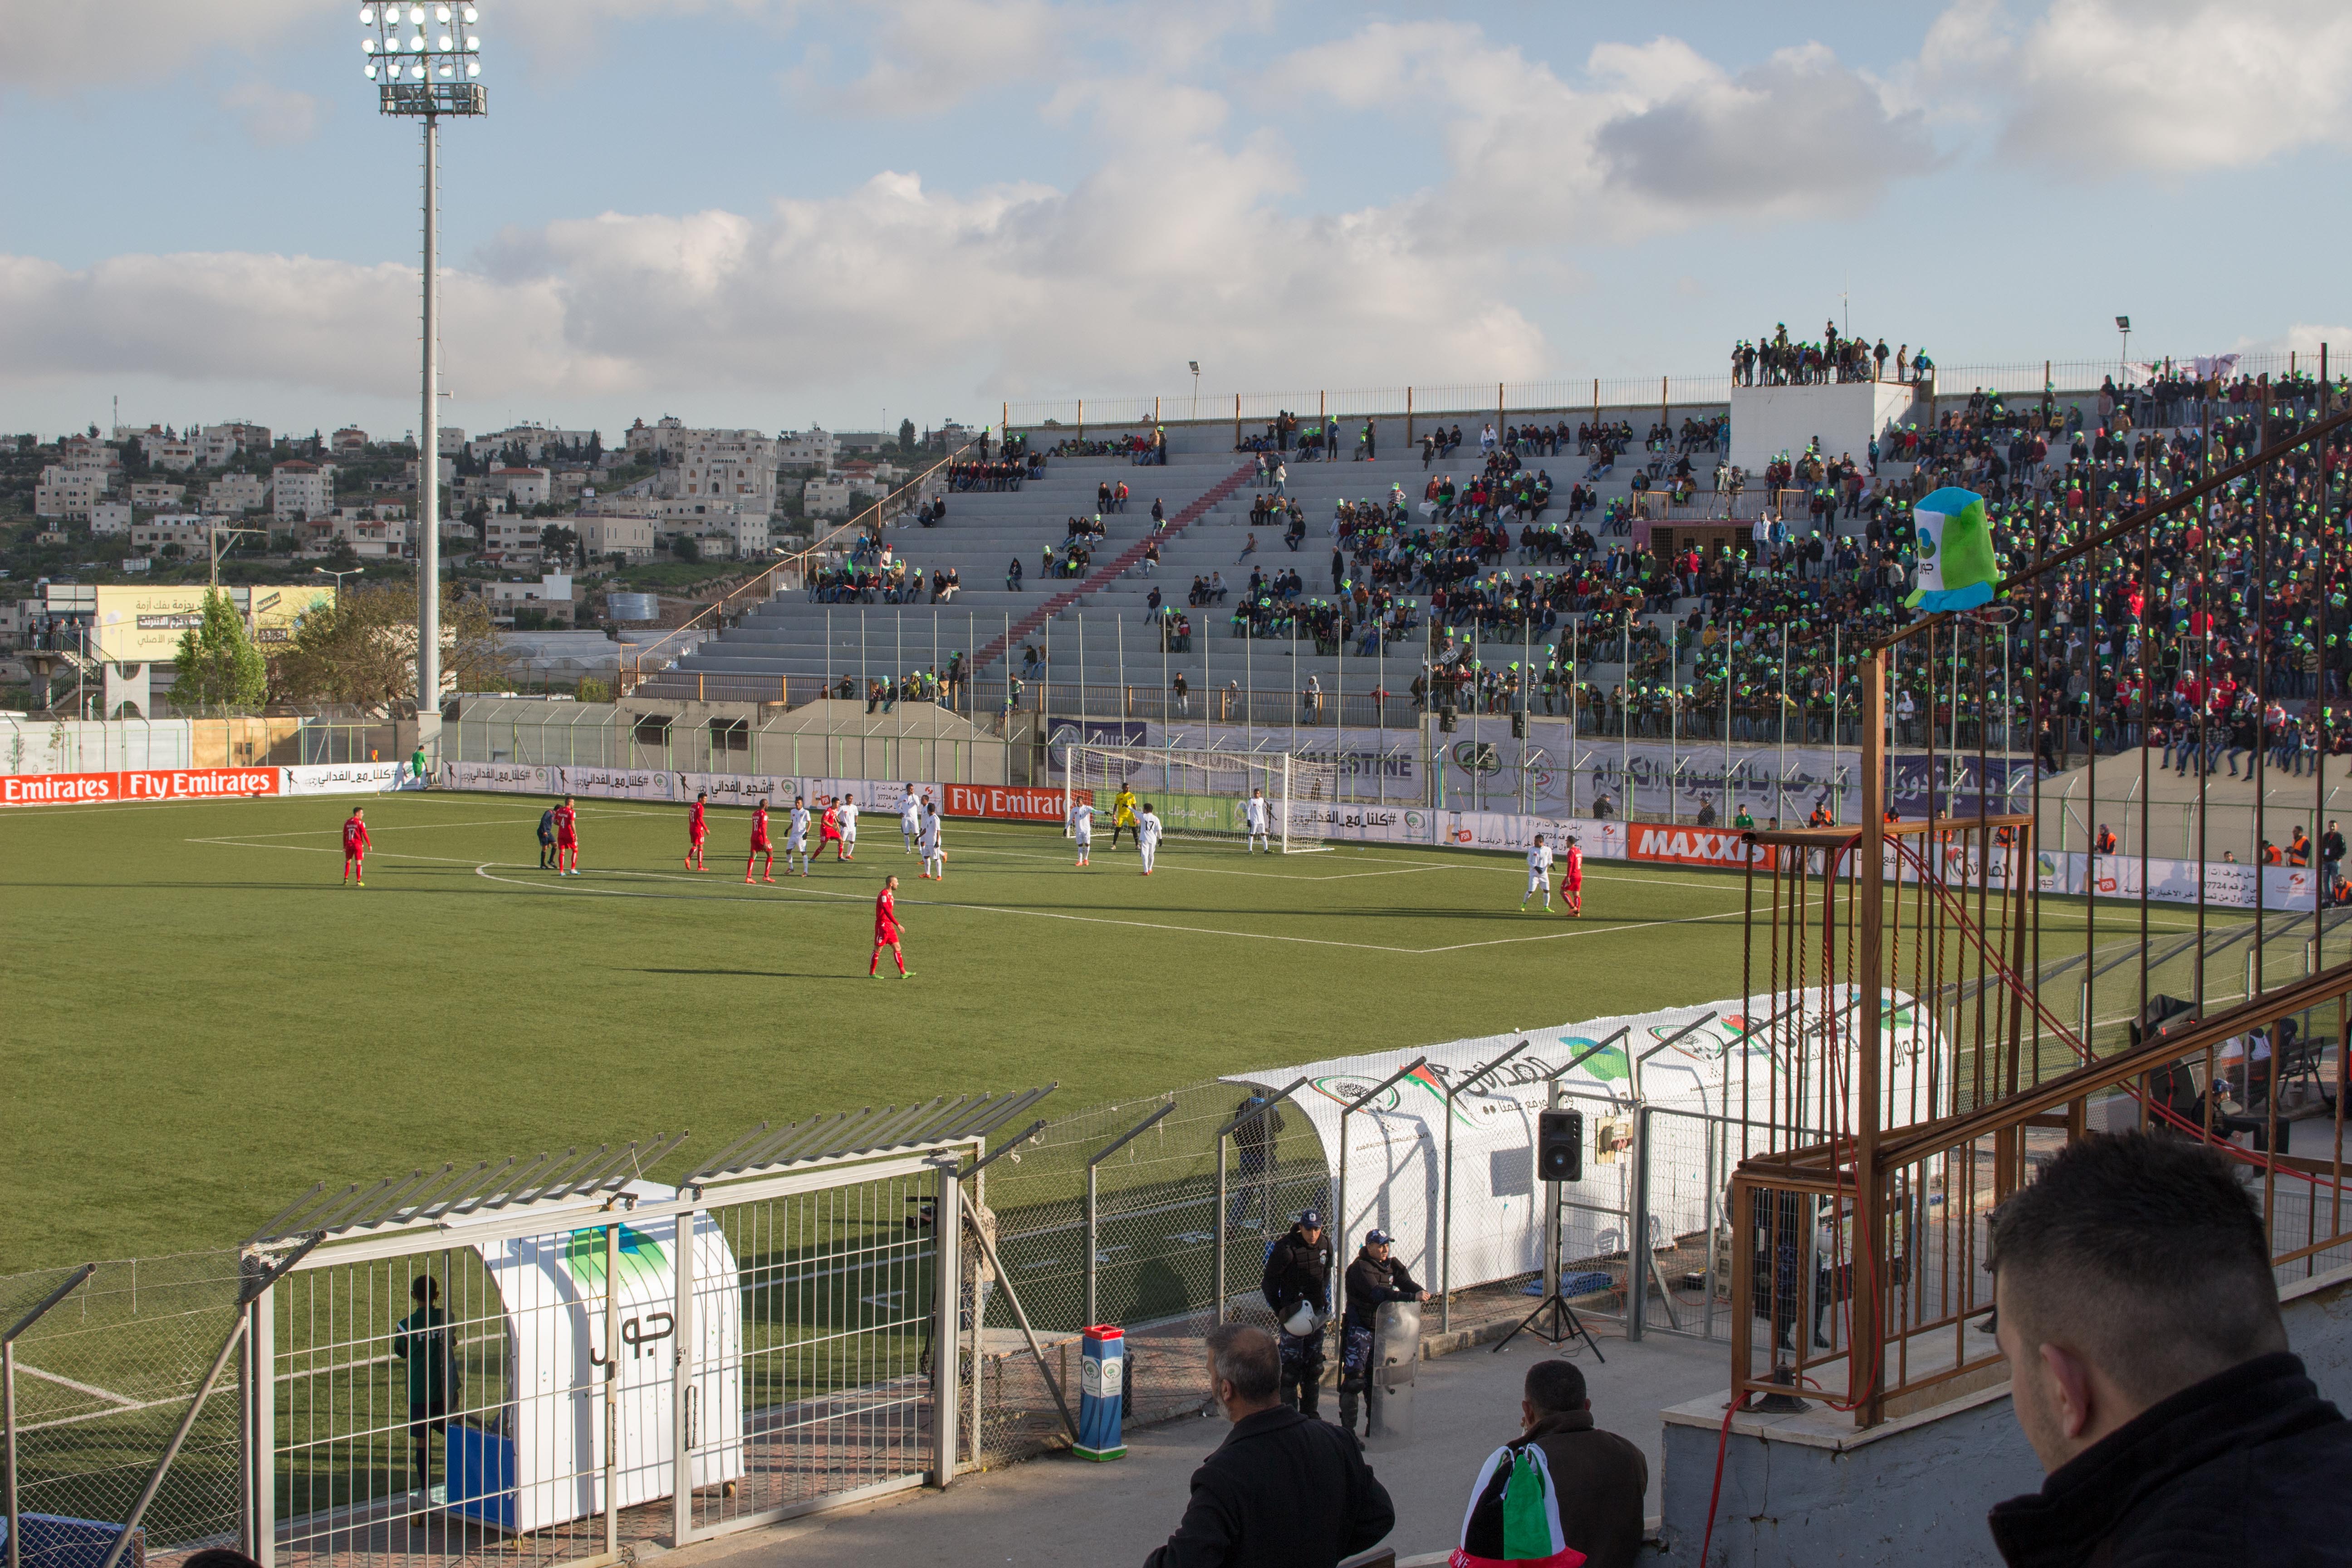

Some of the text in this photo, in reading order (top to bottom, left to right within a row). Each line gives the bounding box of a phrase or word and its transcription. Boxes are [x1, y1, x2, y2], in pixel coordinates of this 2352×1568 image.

[1592, 756, 1659, 792] الكرام
[5, 777, 109, 800] Emirates
[130, 771, 270, 798] Fly Emirates
[953, 788, 1073, 816] Fly Emirate
[561, 817, 565, 828] 4
[754, 819, 758, 831] 15
[1145, 820, 1154, 831] 17
[1460, 832, 1470, 841] PSN
[2102, 881, 2113, 890] PSN
